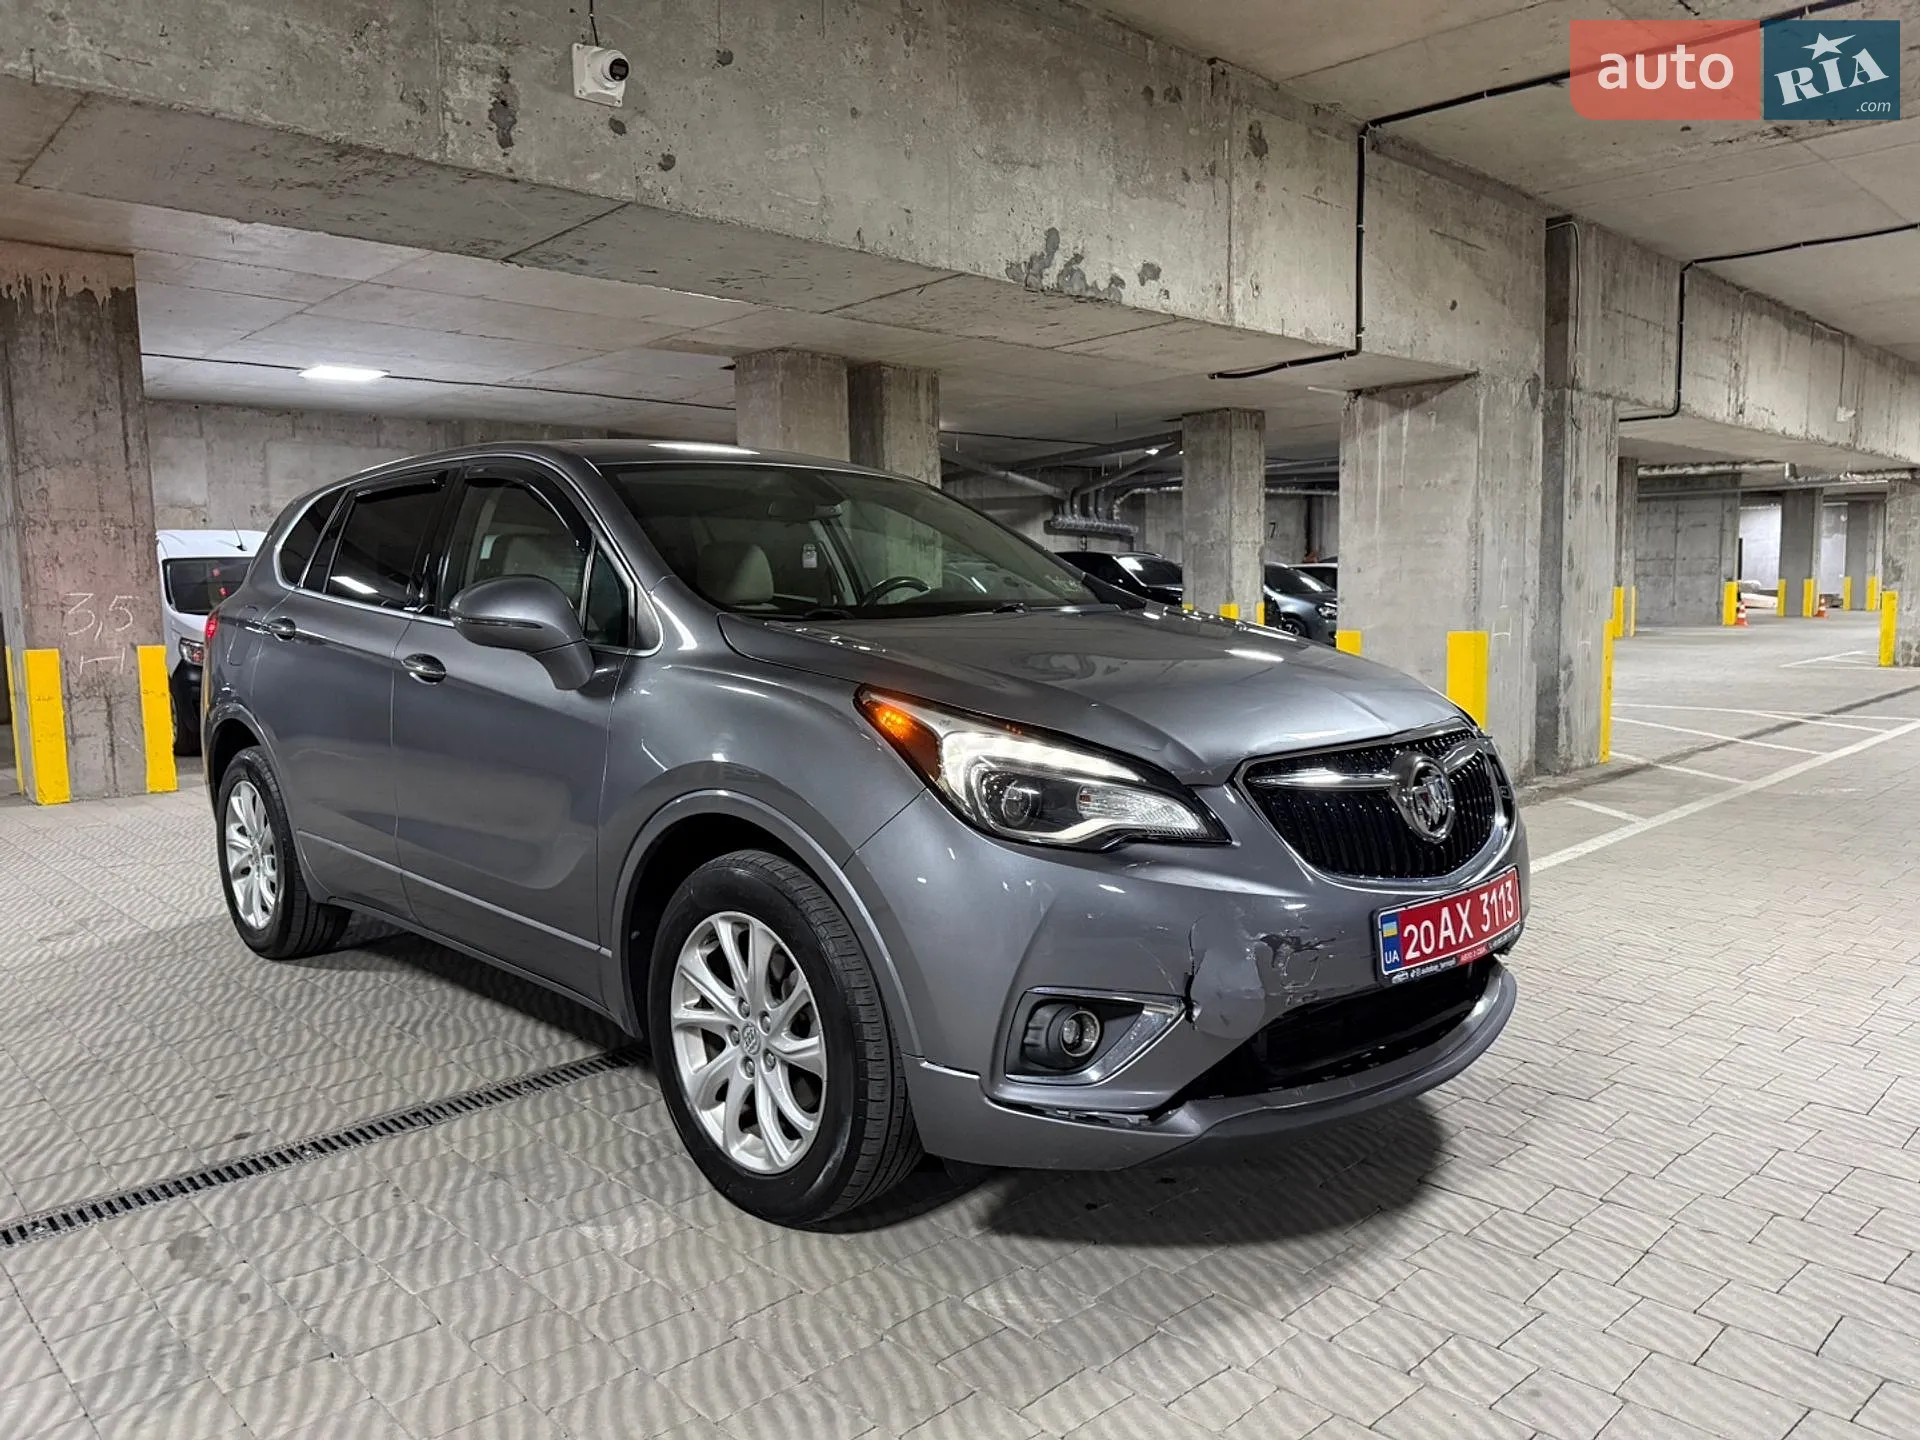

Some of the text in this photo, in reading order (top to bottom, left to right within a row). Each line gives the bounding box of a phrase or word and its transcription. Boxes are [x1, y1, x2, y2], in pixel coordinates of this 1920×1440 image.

[63, 592, 139, 641] 3,5
[1403, 899, 1474, 961] 20AX
[1479, 880, 1514, 933] 3113
[1384, 950, 1400, 964] UA
